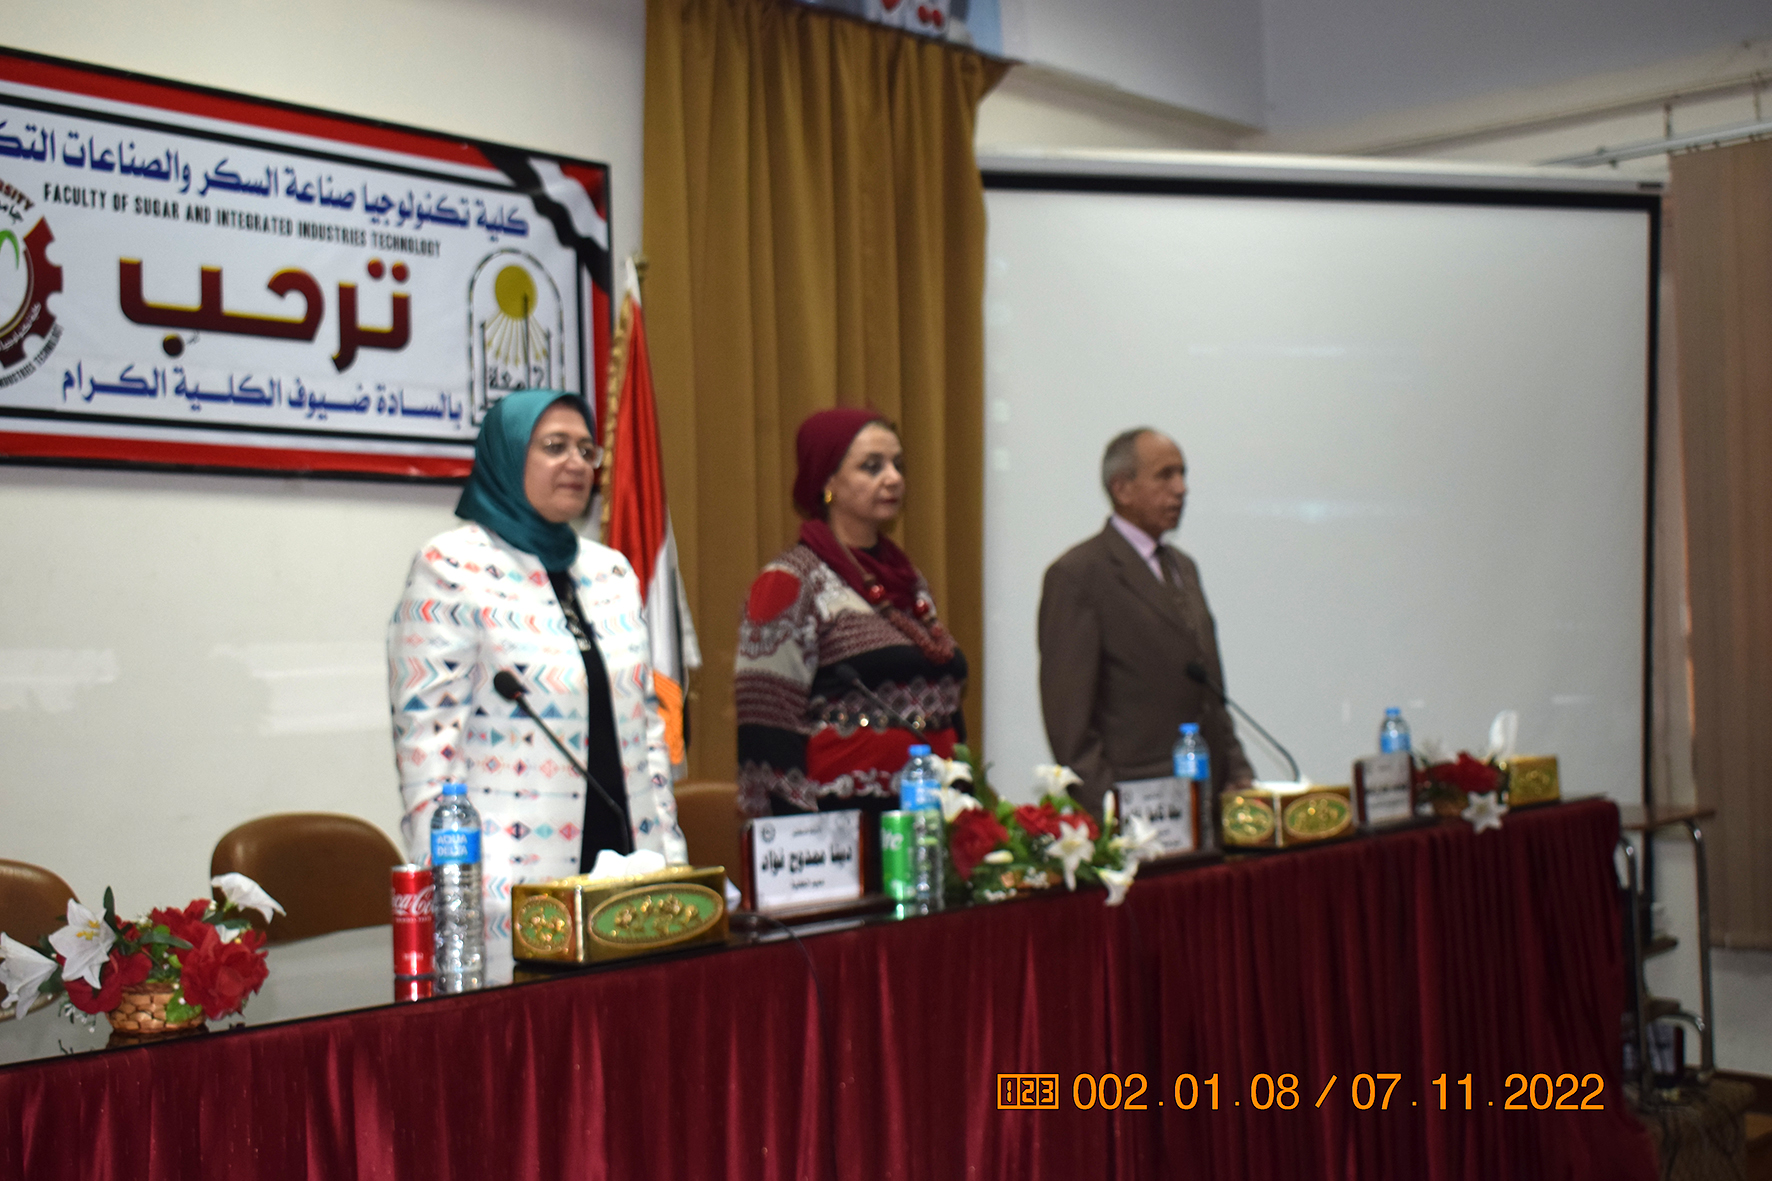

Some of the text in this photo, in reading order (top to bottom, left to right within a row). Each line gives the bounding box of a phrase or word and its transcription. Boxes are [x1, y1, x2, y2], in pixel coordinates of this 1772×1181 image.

[62, 129, 193, 195] والصناعات
[198, 158, 279, 197] السكر
[285, 165, 357, 209] صناعة
[44, 182, 442, 258] FACULTY OF SUGAR AND INTEGRATED INDUSTRIES TECHNOLOGY
[362, 183, 471, 230] تكنولوجيا
[476, 197, 529, 242] كلية
[118, 258, 412, 373] ترحب
[62, 359, 464, 430] بالسادة ضيوف الكلية الكرام
